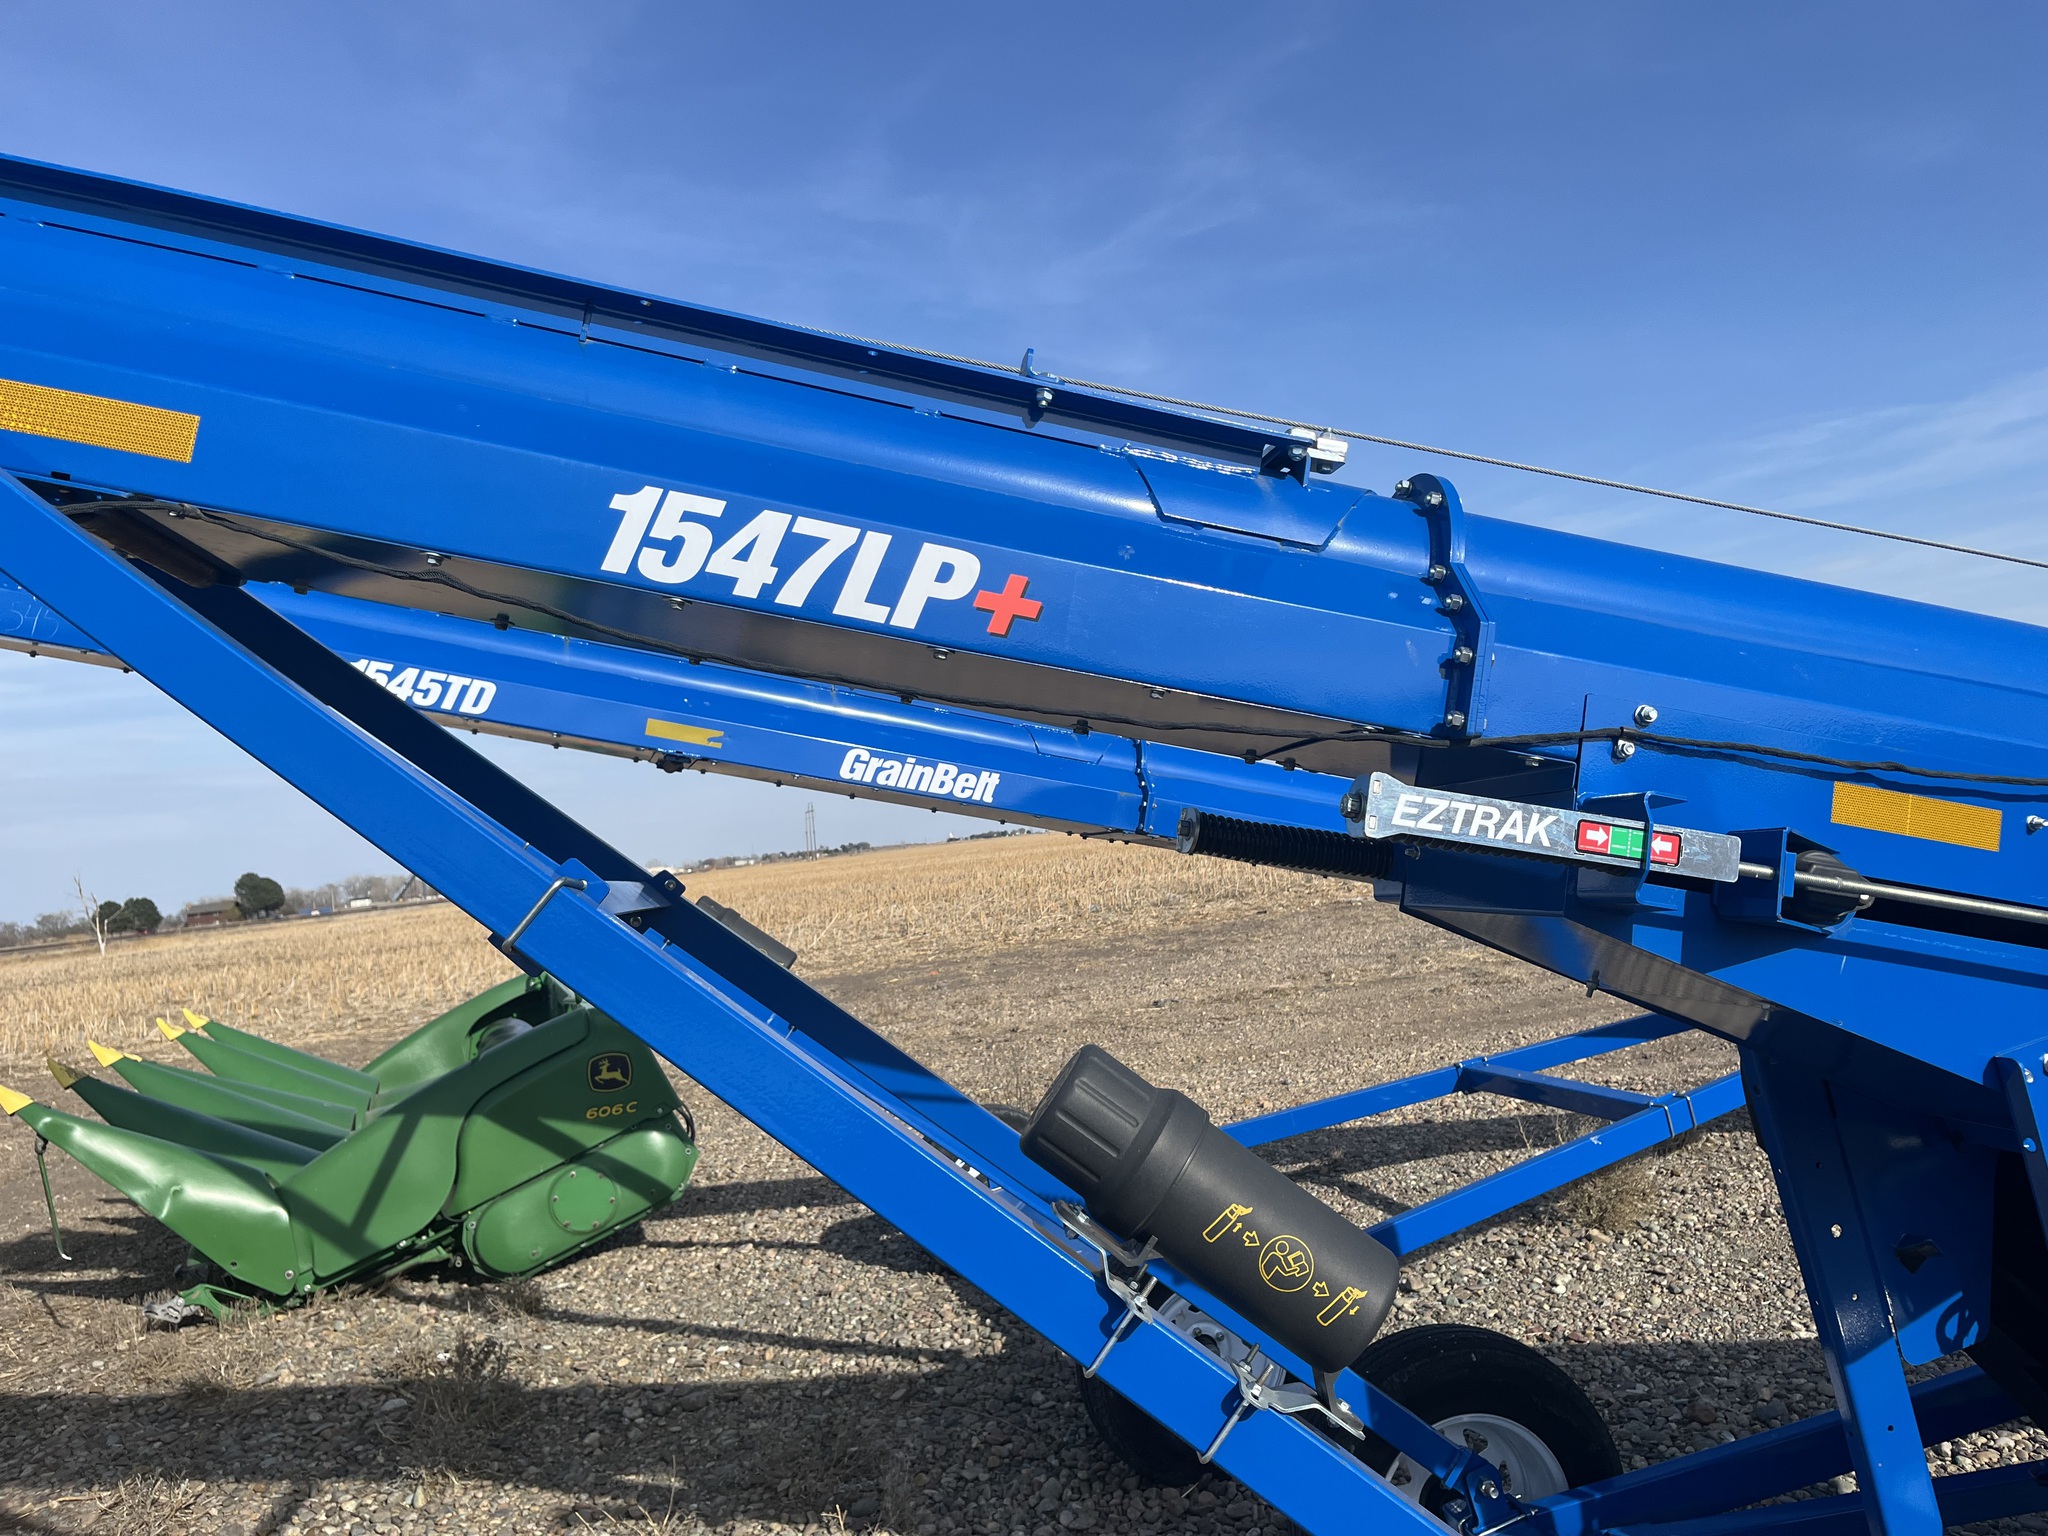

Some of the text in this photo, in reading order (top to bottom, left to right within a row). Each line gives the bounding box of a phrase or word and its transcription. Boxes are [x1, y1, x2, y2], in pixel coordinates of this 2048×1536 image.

[350, 658, 498, 716] 545TD
[839, 747, 1001, 804] GrainBelt
[1391, 793, 1558, 848] EZTRAK
